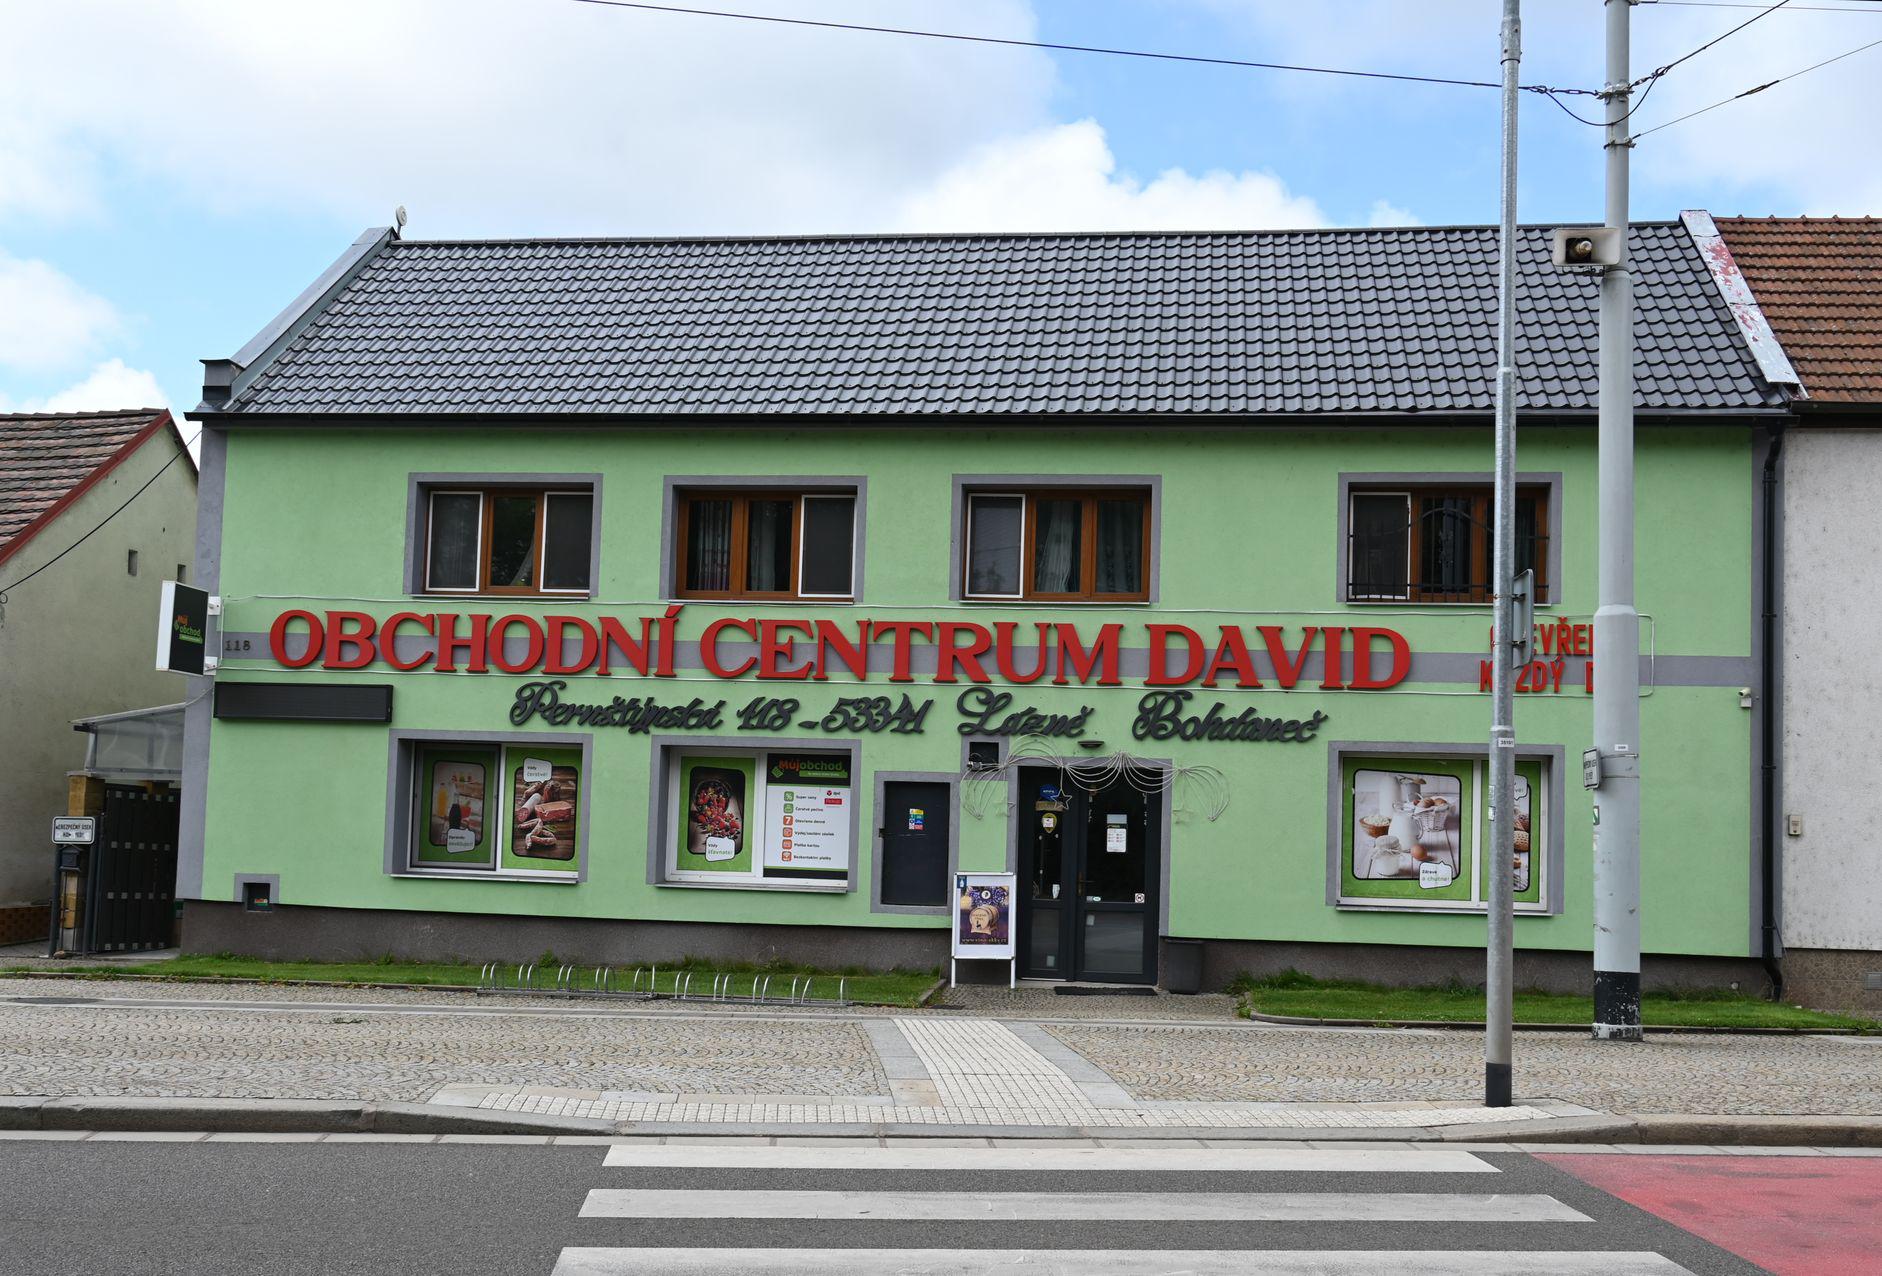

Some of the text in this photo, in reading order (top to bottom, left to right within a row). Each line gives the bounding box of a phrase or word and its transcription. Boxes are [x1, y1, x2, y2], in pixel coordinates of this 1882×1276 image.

[224, 640, 252, 652] 118
[269, 605, 681, 677] OBCHODNÍ
[699, 618, 1124, 685] CENTRUM
[1145, 624, 1411, 688] DAVID
[736, 696, 800, 732] 118
[820, 692, 934, 735] 53341
[956, 686, 1095, 738] Lázně
[1131, 689, 1329, 743] Bohdaneč
